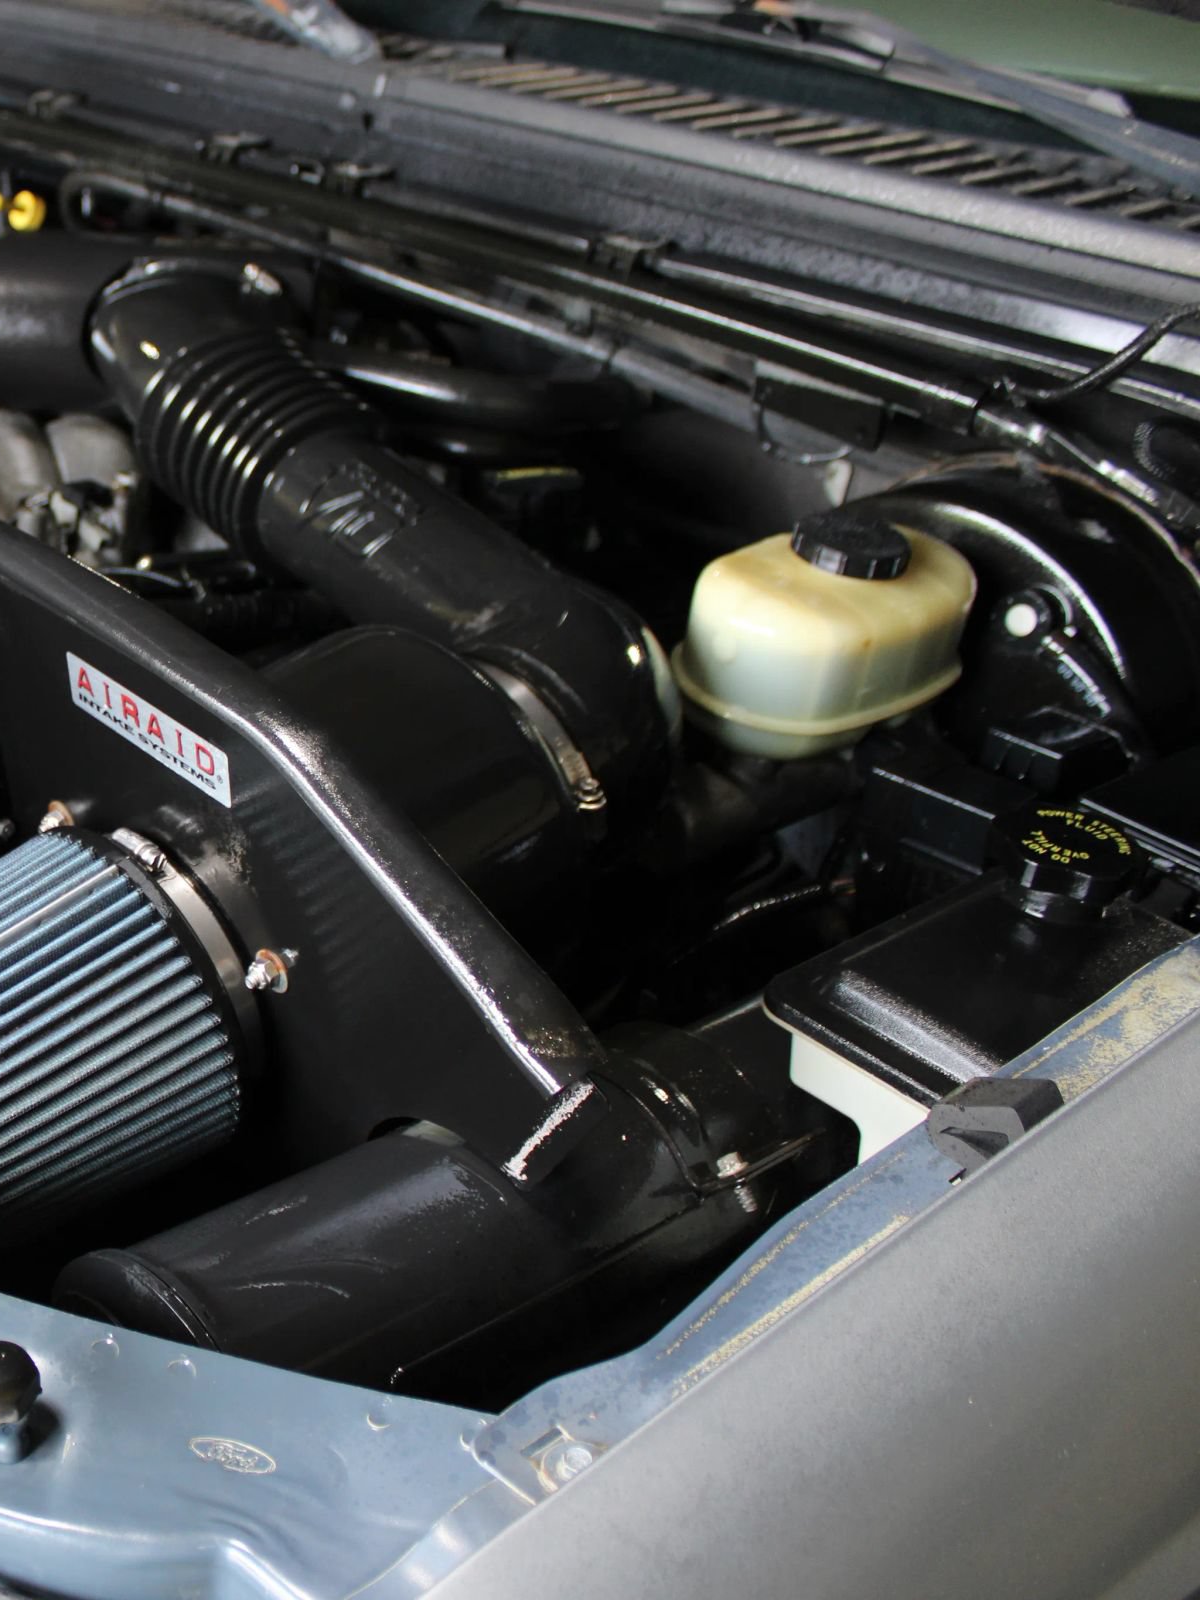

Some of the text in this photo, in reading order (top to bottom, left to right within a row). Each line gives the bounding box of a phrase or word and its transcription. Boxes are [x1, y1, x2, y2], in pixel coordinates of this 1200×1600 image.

[77, 667, 215, 776] AIRAID
[78, 693, 217, 790] INTAKE SYSTEMS
[1037, 810, 1085, 821] POWER
[1066, 819, 1109, 840] FLUID
[1021, 839, 1070, 864] DO NOT
